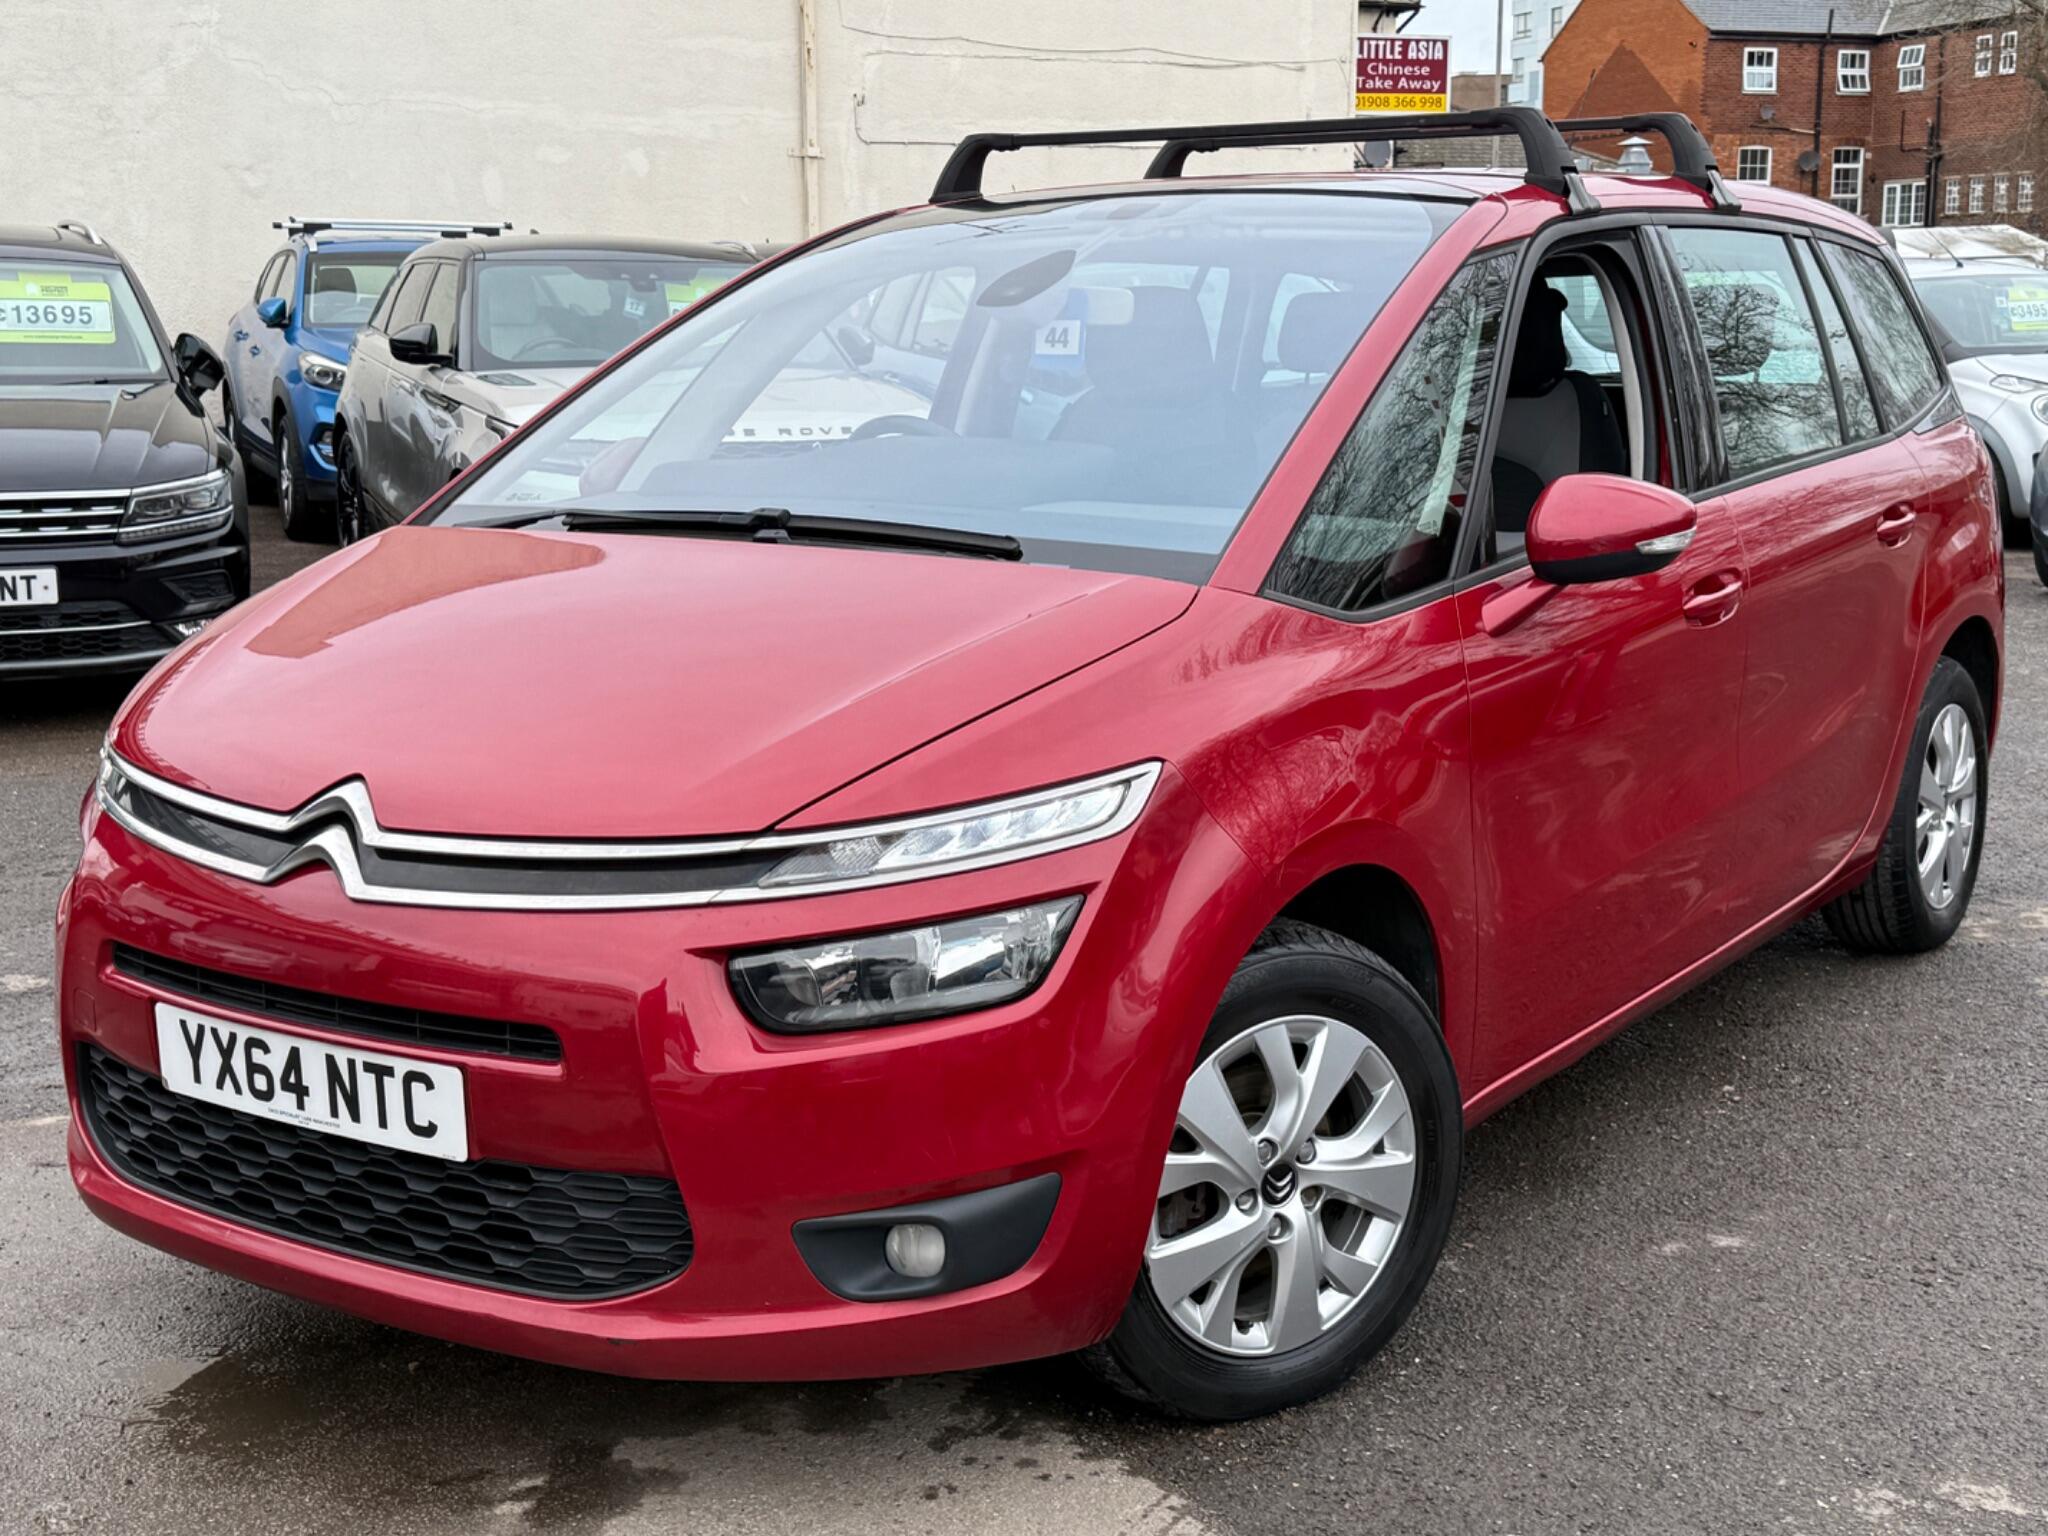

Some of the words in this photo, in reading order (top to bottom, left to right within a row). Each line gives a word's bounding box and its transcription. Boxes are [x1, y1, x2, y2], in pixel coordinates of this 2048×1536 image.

[1358, 40, 1403, 59] ITTLE
[1408, 40, 1443, 60] ASIA
[1367, 62, 1430, 75] Chinese
[1357, 76, 1393, 89] Take
[1397, 77, 1441, 92] Away
[1394, 96, 1416, 108] 366
[1420, 96, 1442, 108] 998
[1044, 326, 1069, 349] 44
[778, 426, 852, 437] ROVE
[0, 575, 37, 601] NT
[179, 1018, 310, 1111] YX64
[325, 1053, 438, 1139] NTC
